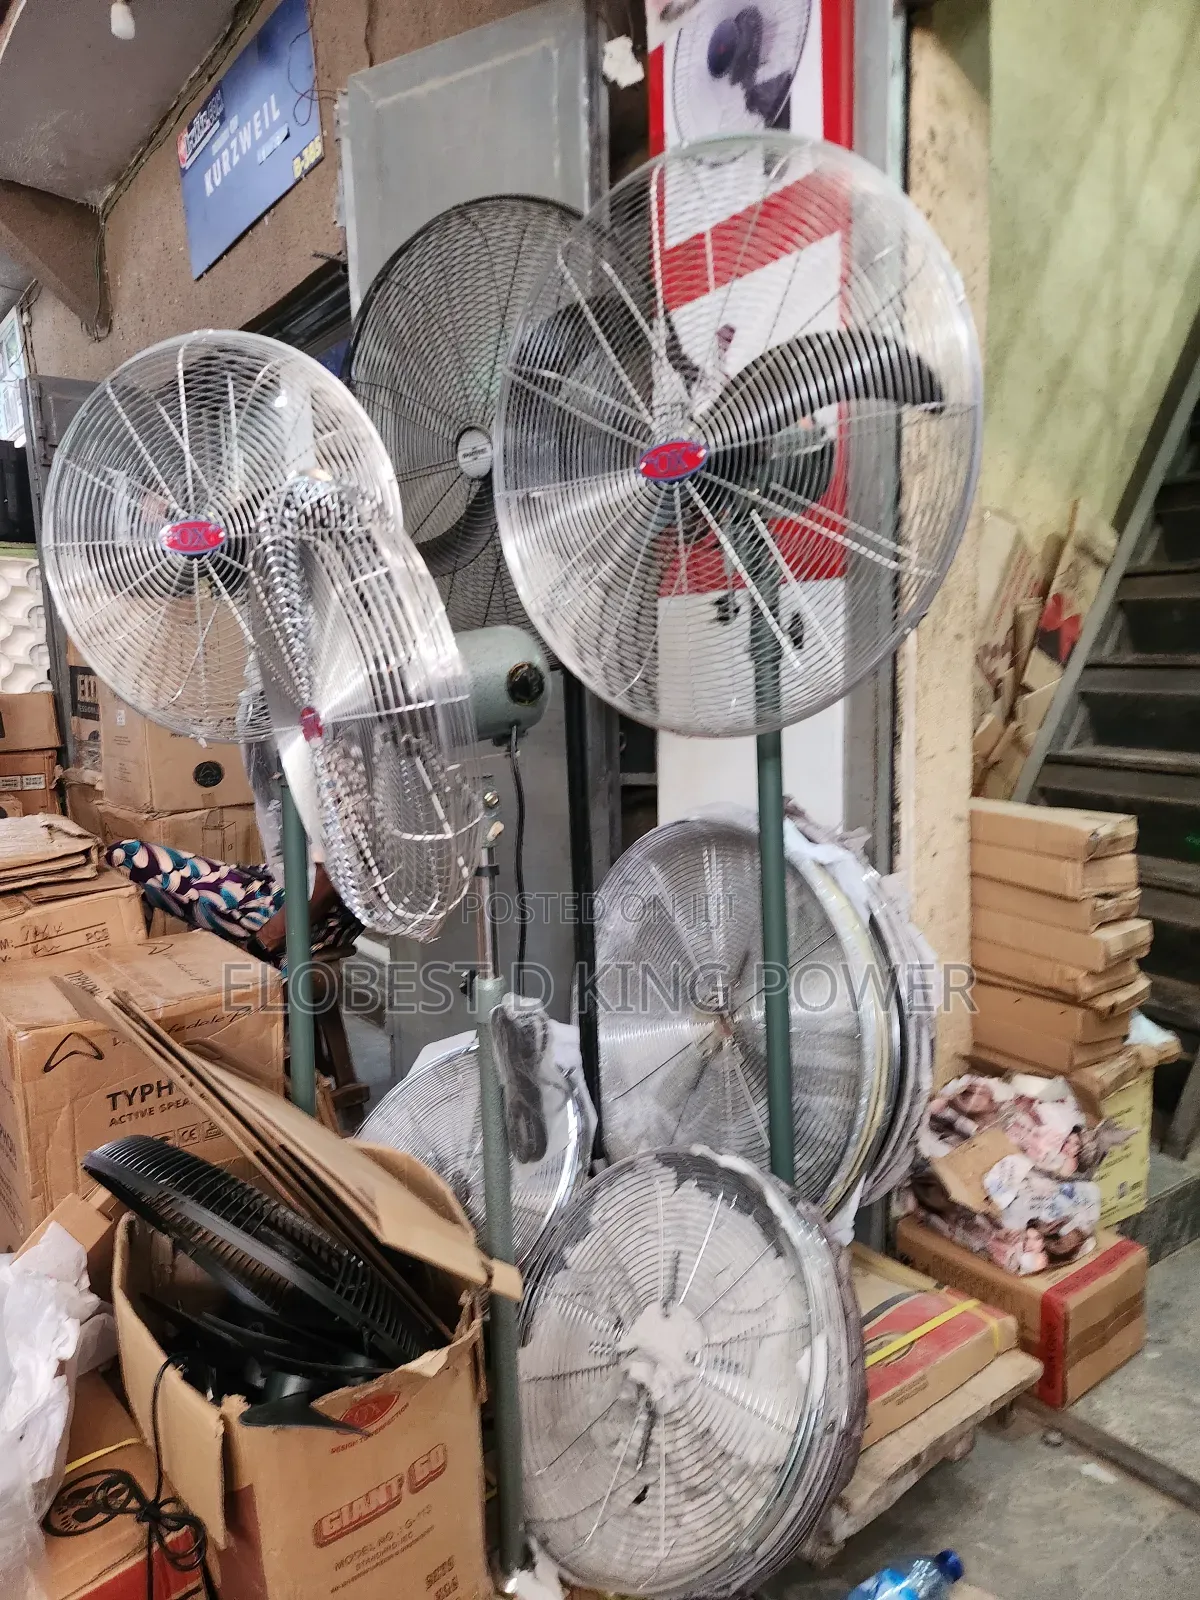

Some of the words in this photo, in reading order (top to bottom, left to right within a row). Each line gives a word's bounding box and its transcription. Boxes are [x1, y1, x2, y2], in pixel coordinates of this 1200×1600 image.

[204, 93, 281, 198] KURZWEIL
[106, 1079, 176, 1112] TYPH
[108, 1105, 155, 1127] ACTIVE
[159, 1097, 195, 1113] SPEA
[313, 1473, 405, 1549] GIANT
[334, 1543, 376, 1572] MODEL
